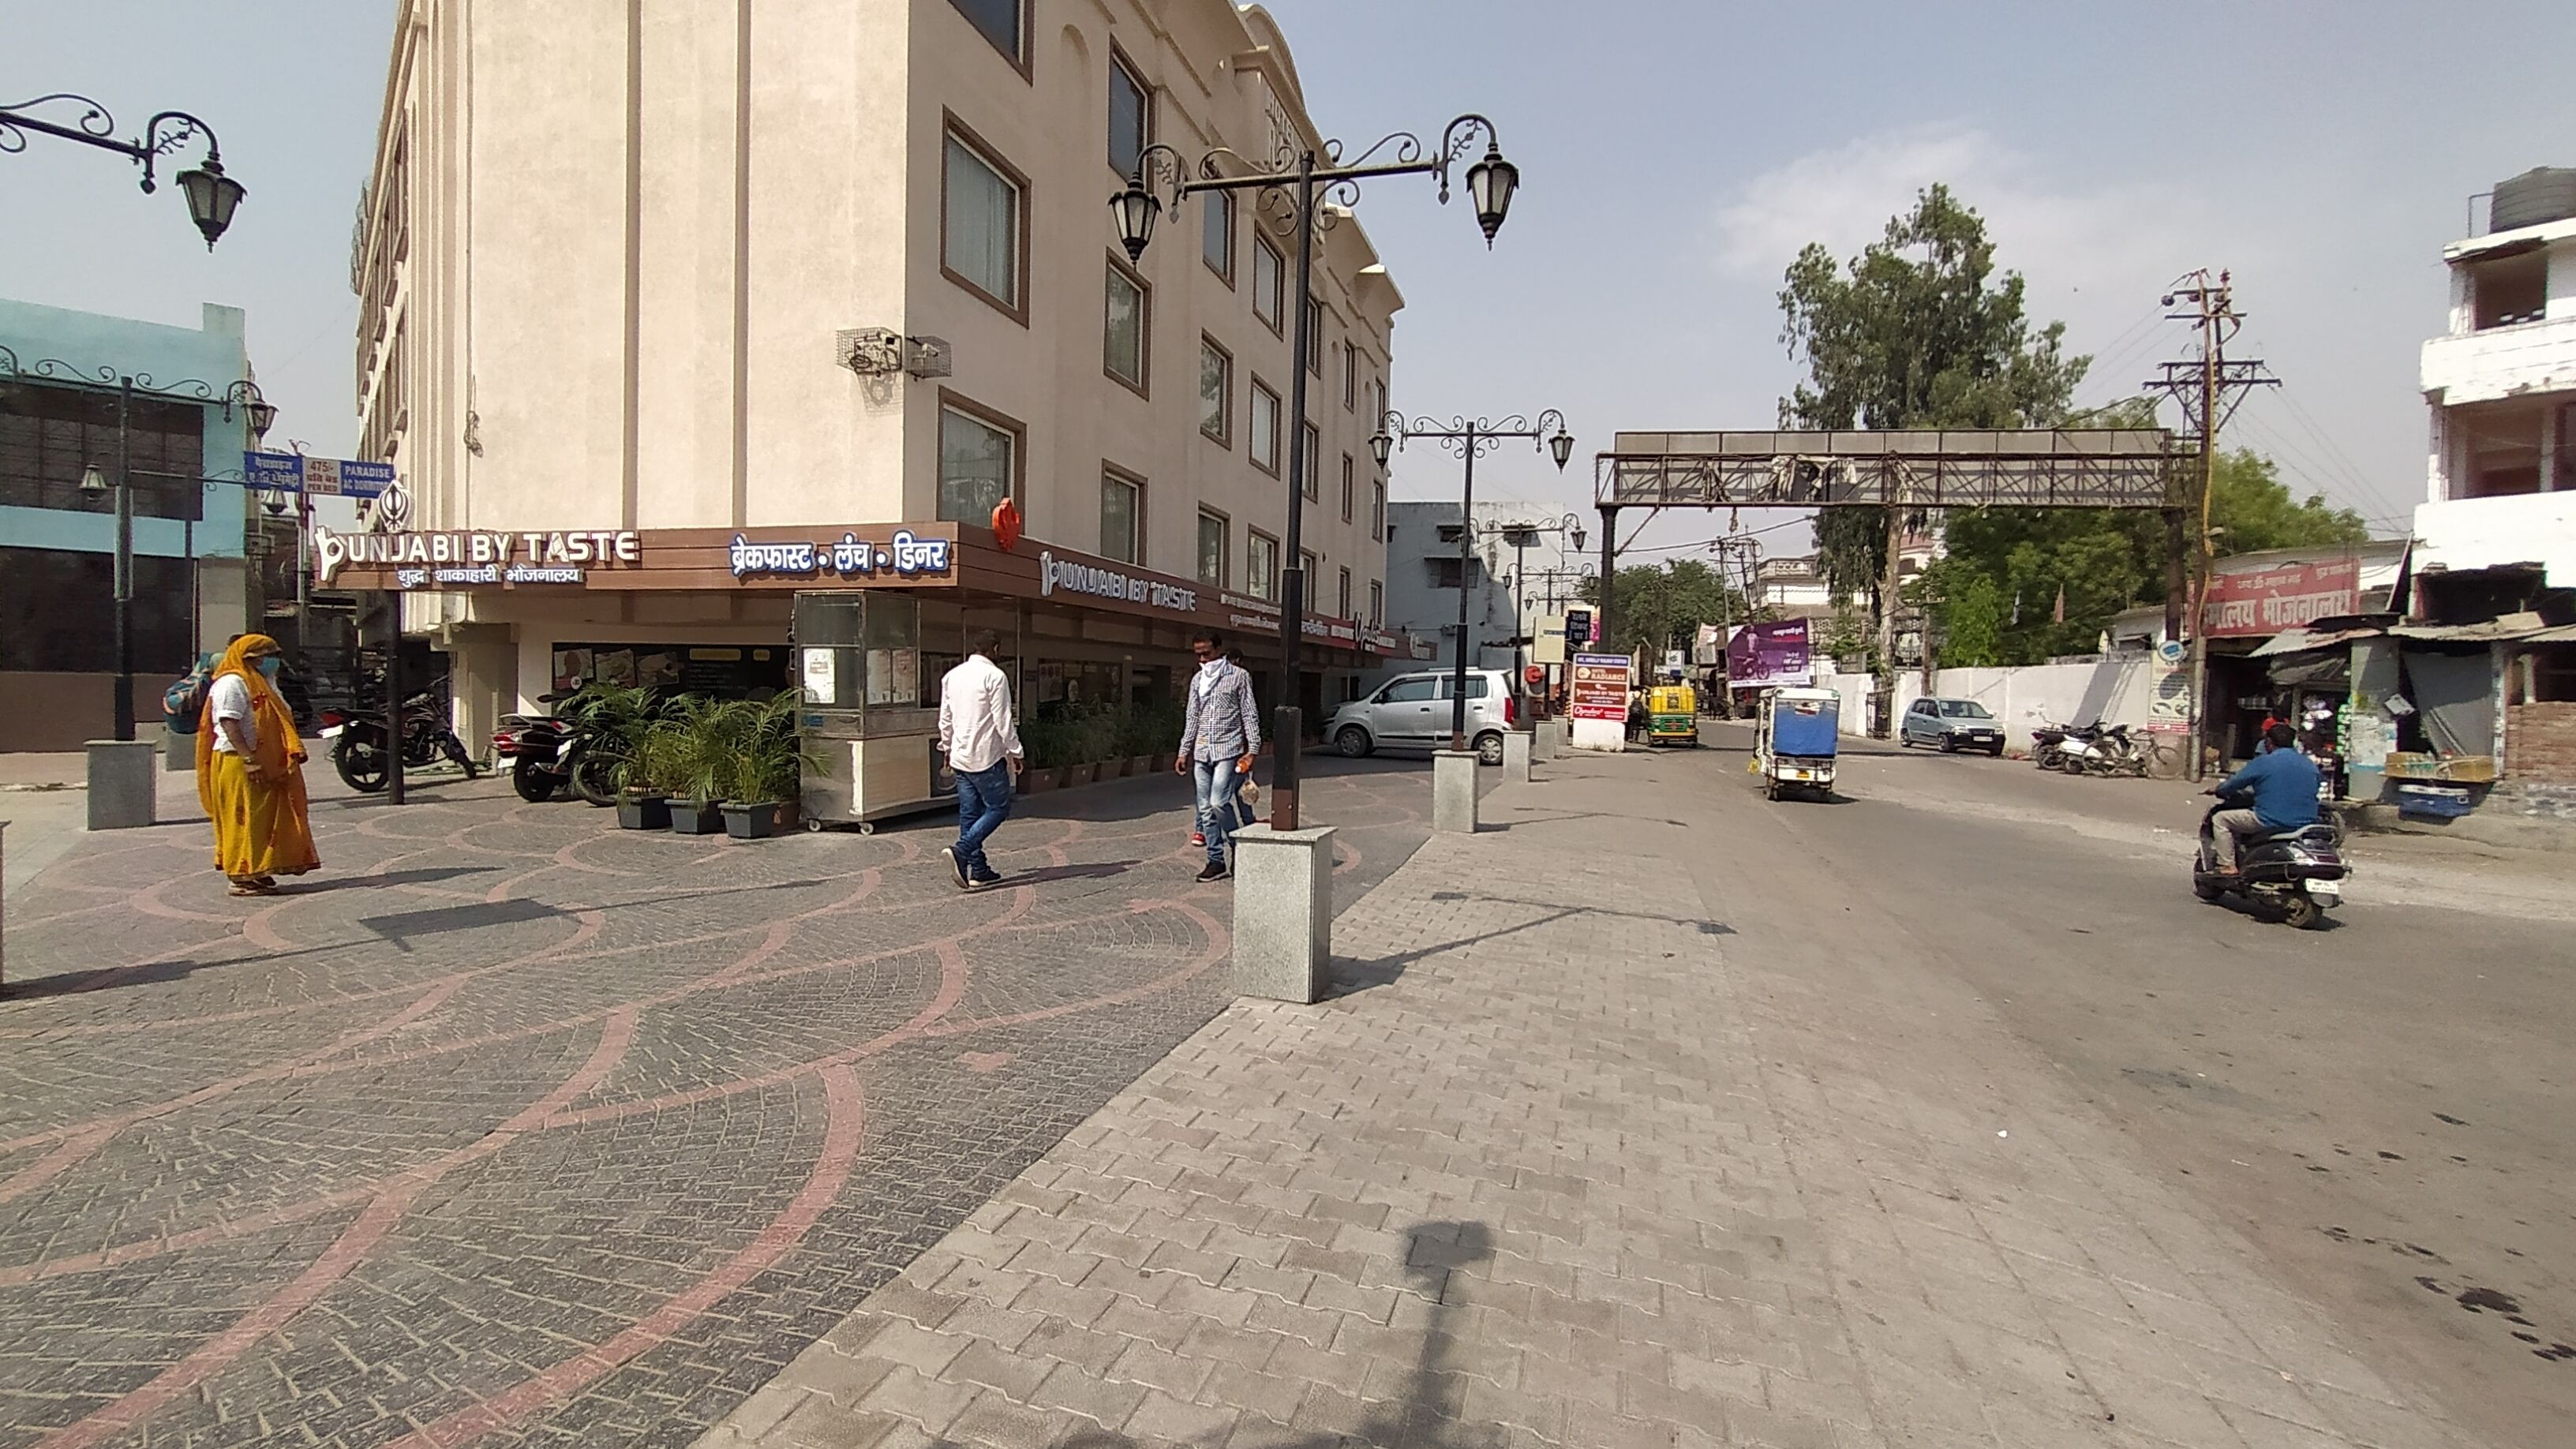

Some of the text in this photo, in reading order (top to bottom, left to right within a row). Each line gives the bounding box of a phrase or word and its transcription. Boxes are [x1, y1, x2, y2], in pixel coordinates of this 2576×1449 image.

[343, 479, 354, 490] AC
[345, 465, 391, 479] PARADISE
[314, 526, 638, 582] PUNJABI BY TASTE
[730, 530, 949, 577] ब्रेकफास्ट लंच डिनर
[397, 563, 581, 589] शुद्ध शाकाहारी भोजनालय
[1039, 549, 1197, 612] PUNJABI BY TASTE
[2263, 588, 2352, 627] भोजनालय
